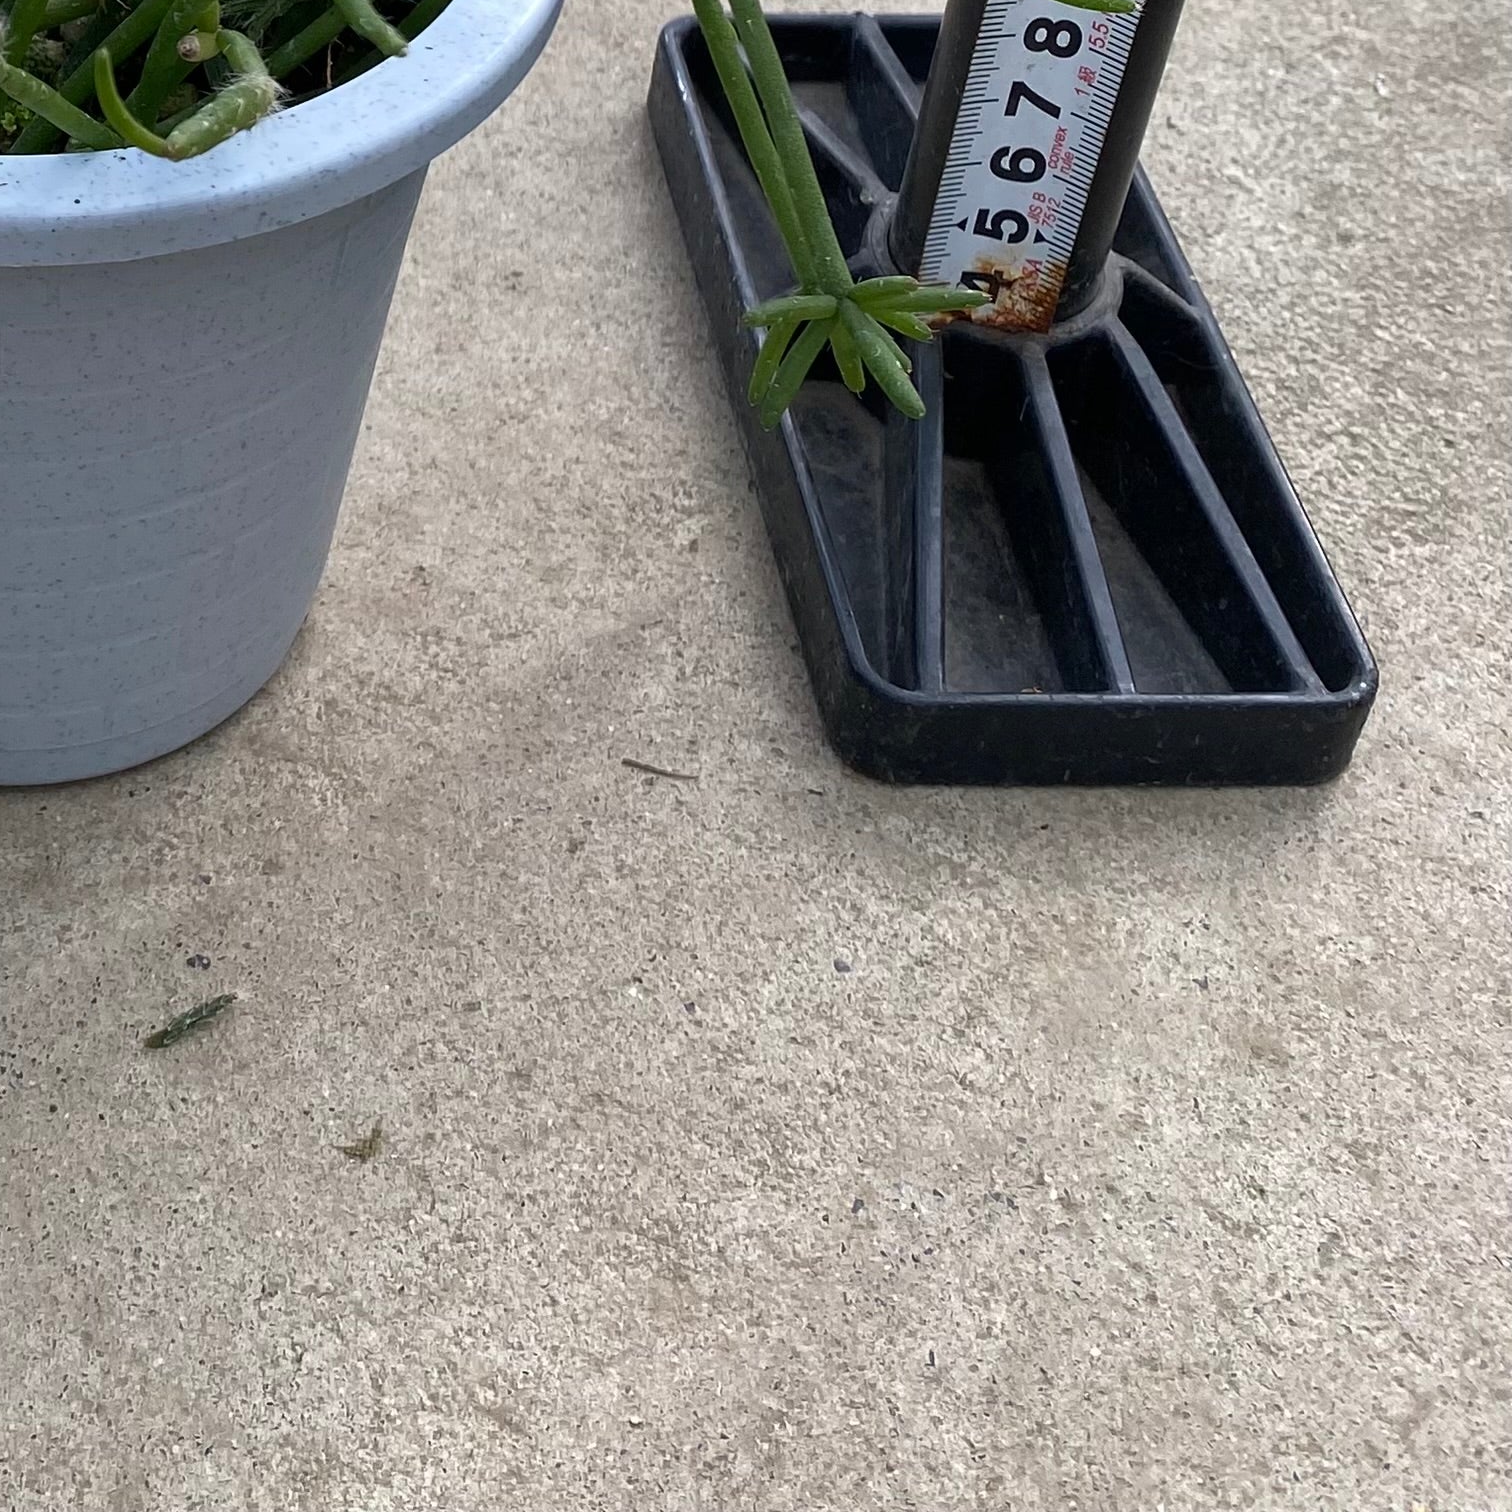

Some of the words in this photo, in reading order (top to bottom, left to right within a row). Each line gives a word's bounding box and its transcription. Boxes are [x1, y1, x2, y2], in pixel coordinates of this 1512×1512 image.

[1023, 17, 1083, 58] 8
[1004, 80, 1062, 119] 7
[989, 145, 1047, 183] 6
[1048, 125, 1068, 169] convex
[1032, 192, 1047, 203] B
[973, 208, 1029, 244] 5
